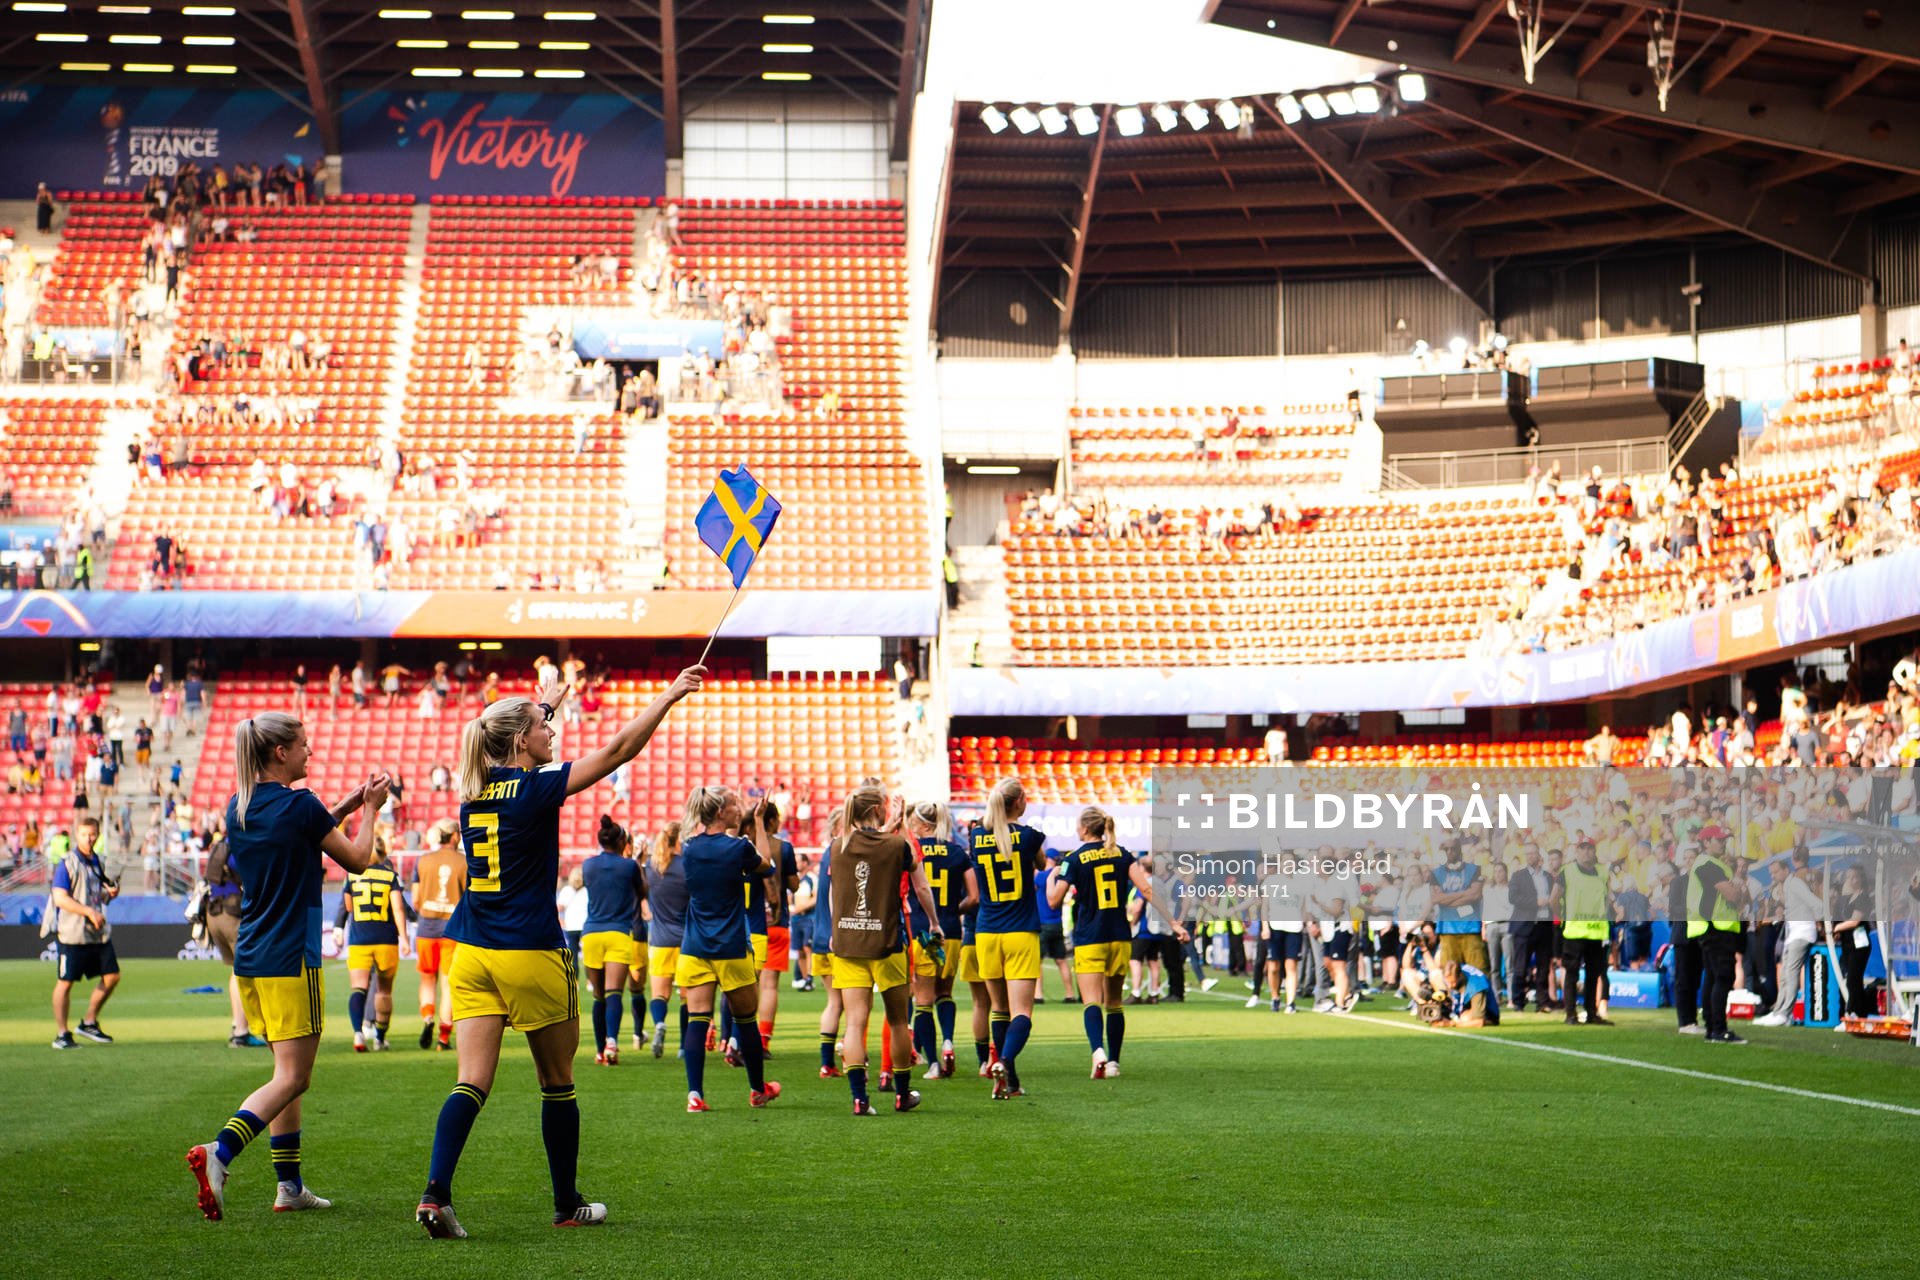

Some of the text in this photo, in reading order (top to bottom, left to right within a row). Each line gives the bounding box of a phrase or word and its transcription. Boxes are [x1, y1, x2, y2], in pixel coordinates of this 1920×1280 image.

[129, 135, 219, 158] FRANCE
[130, 155, 178, 177] 2019
[418, 102, 590, 199] Victory
[468, 812, 501, 892] 3
[921, 844, 948, 857] GLAS
[977, 851, 1023, 903] 13
[1094, 864, 1119, 910] 6
[351, 881, 392, 922] 23
[838, 921, 882, 931] FRANCE 2019
